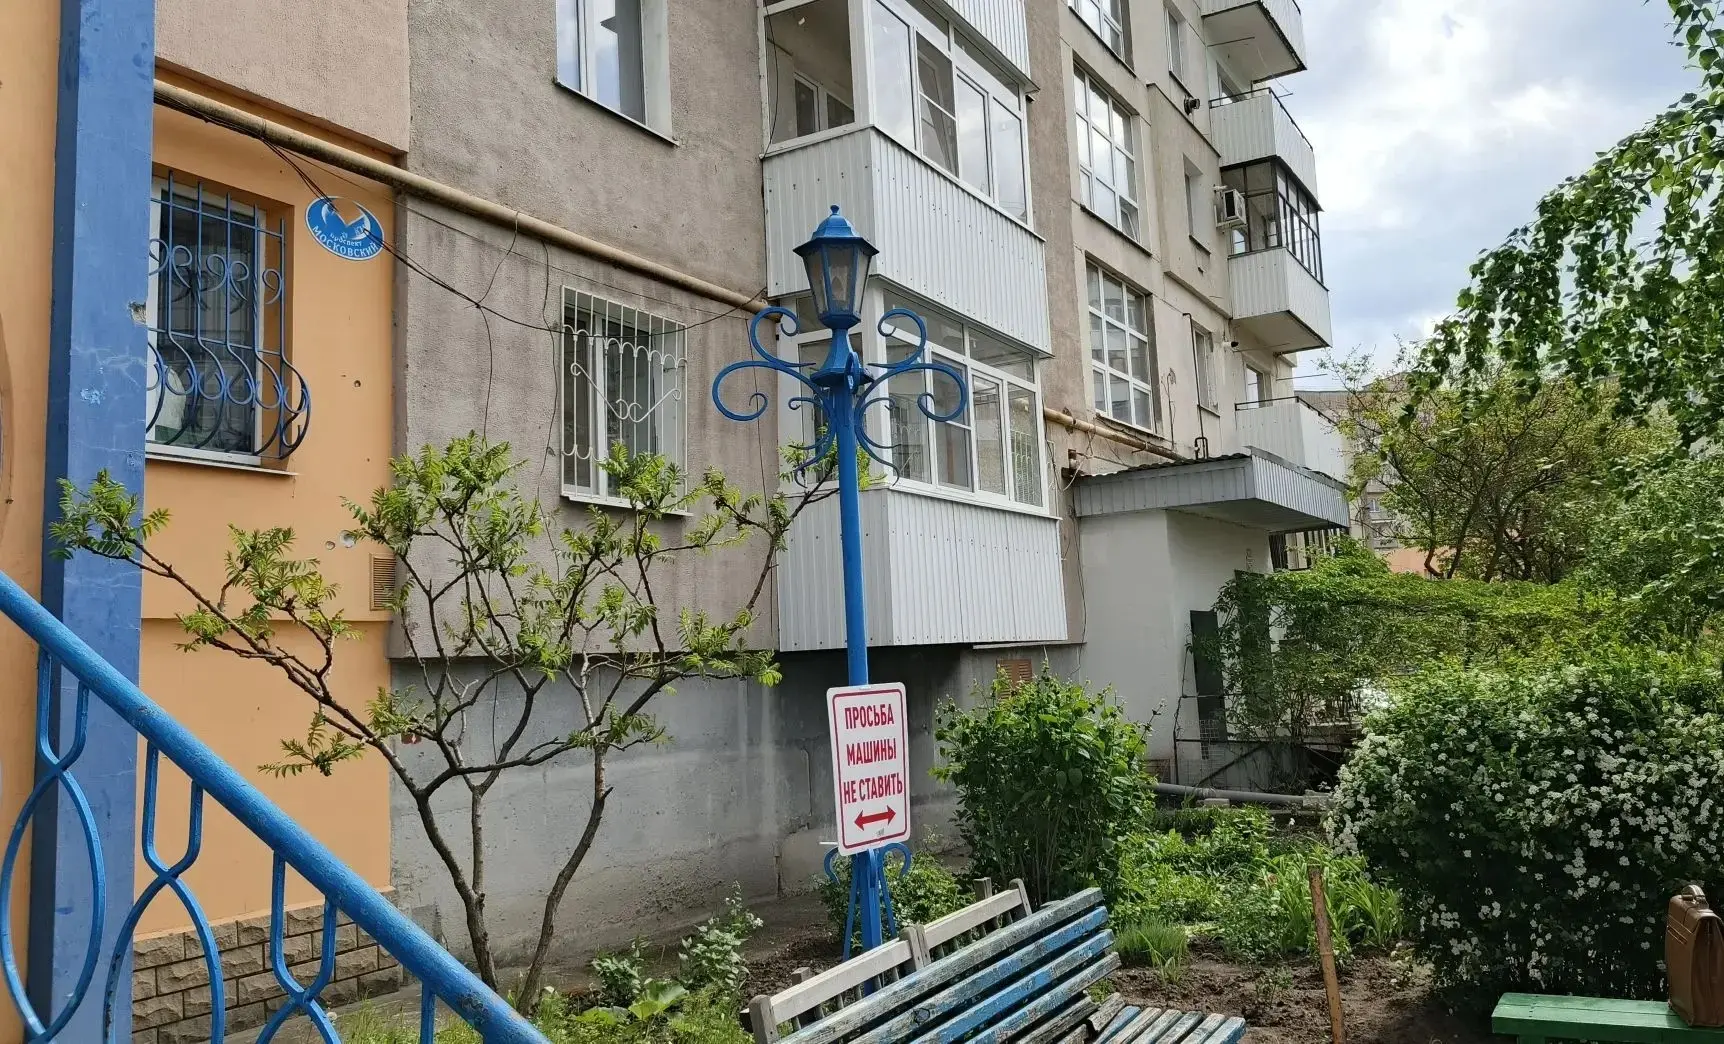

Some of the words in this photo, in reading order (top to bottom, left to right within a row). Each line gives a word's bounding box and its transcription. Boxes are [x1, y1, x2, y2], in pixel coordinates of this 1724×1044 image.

[312, 225, 379, 257] МОСКОВСКИЙ
[844, 703, 895, 730] ПРОСЬБА
[846, 737, 897, 767] МАШИНЫ
[843, 780, 857, 805] НЕ
[858, 772, 903, 802] СТАВИТЬ
